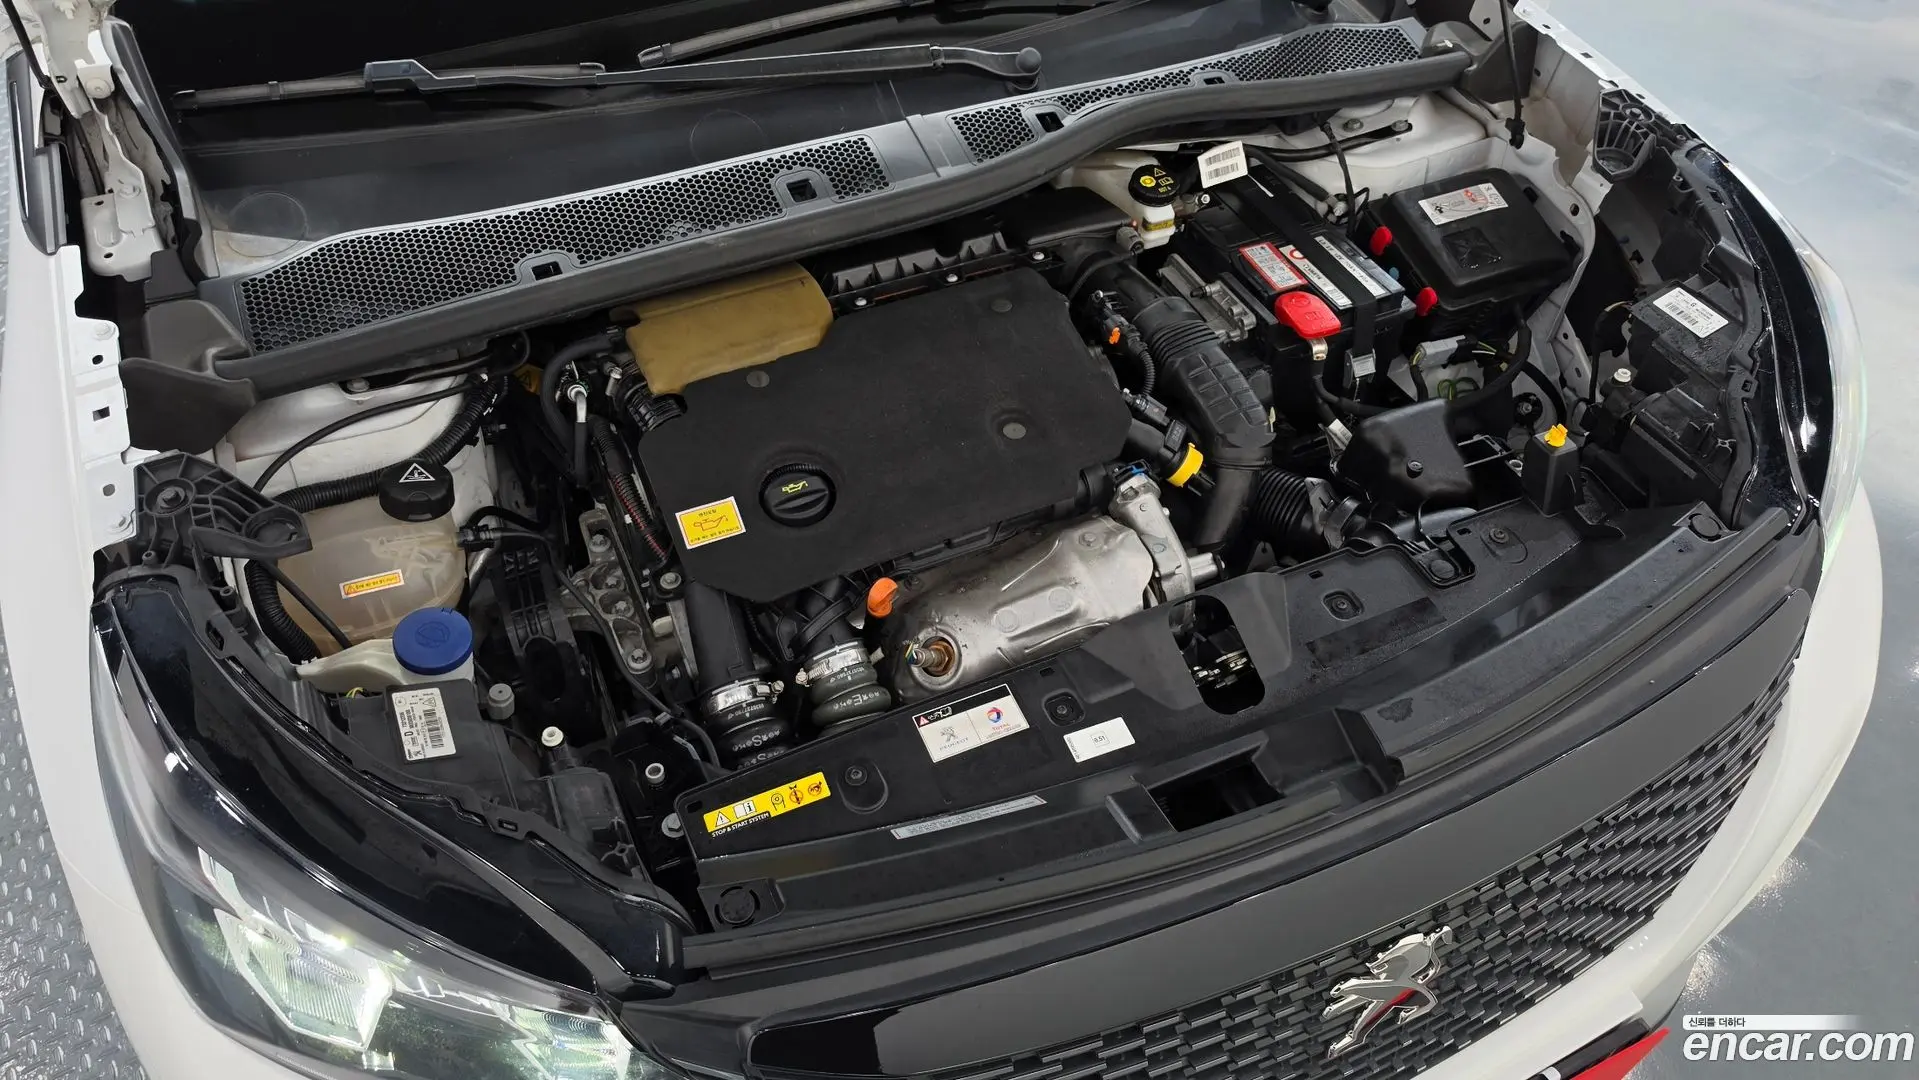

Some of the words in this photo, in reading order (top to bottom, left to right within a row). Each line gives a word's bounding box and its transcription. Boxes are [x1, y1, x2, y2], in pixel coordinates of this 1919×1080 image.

[939, 737, 969, 750] PEUGEOT
[711, 829, 727, 838] STOP
[731, 820, 748, 830] START
[748, 812, 769, 824] SYSTEM
